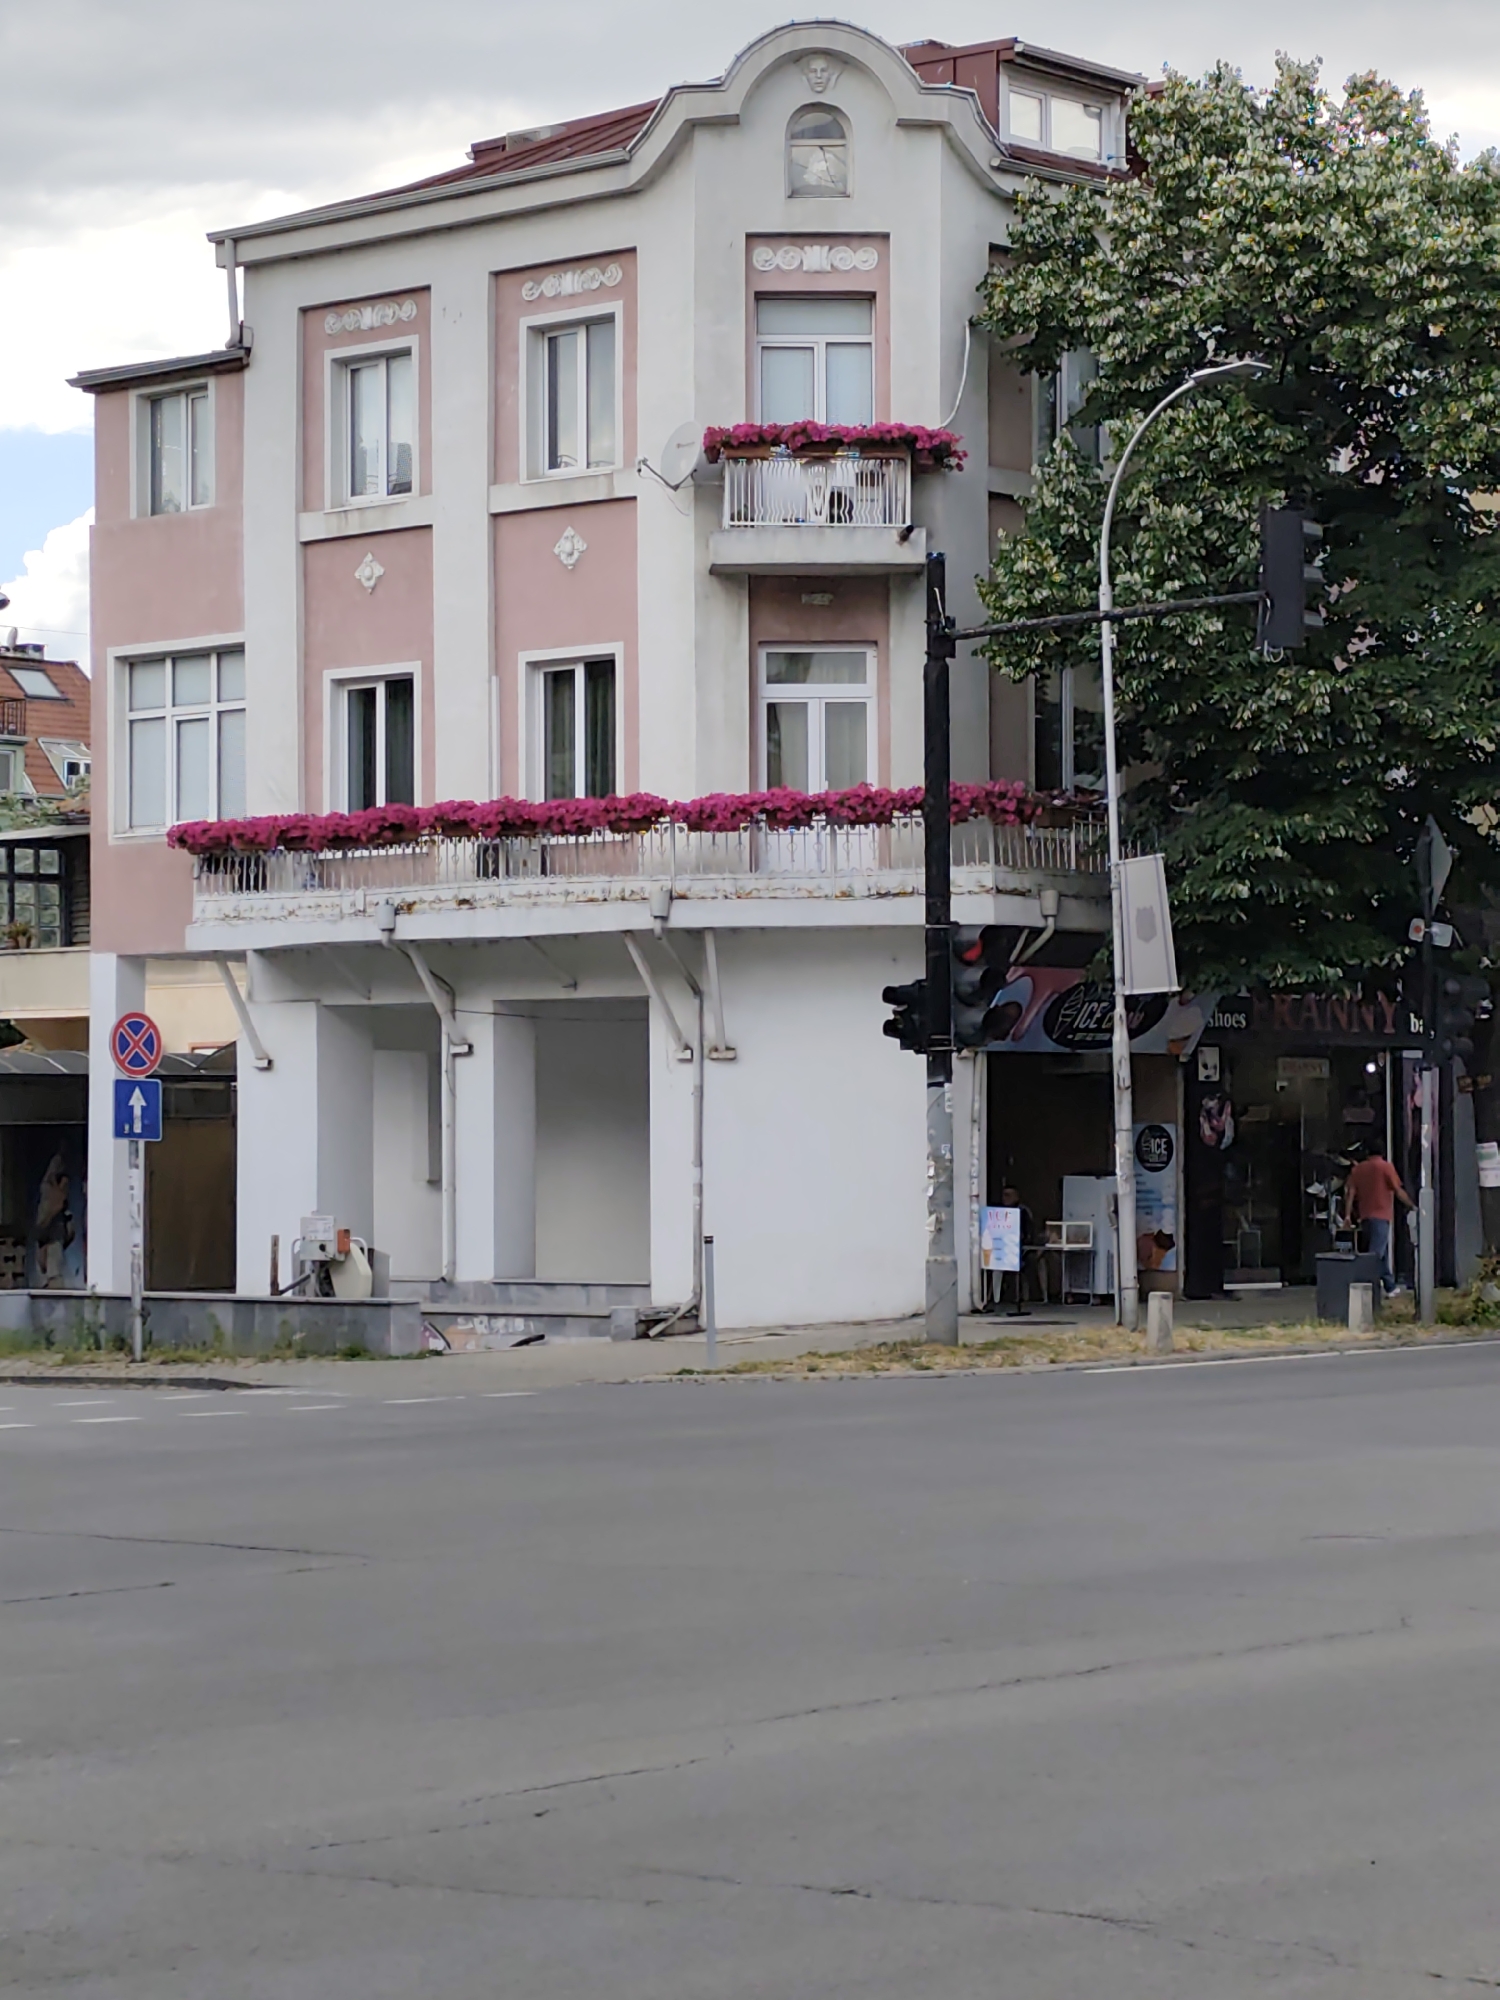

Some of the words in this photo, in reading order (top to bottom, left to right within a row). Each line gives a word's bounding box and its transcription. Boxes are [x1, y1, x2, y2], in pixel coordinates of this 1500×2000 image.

[1073, 1001, 1110, 1029] ICE
[1207, 1009, 1247, 1028] shoes
[1151, 1138, 1169, 1155] ICE
